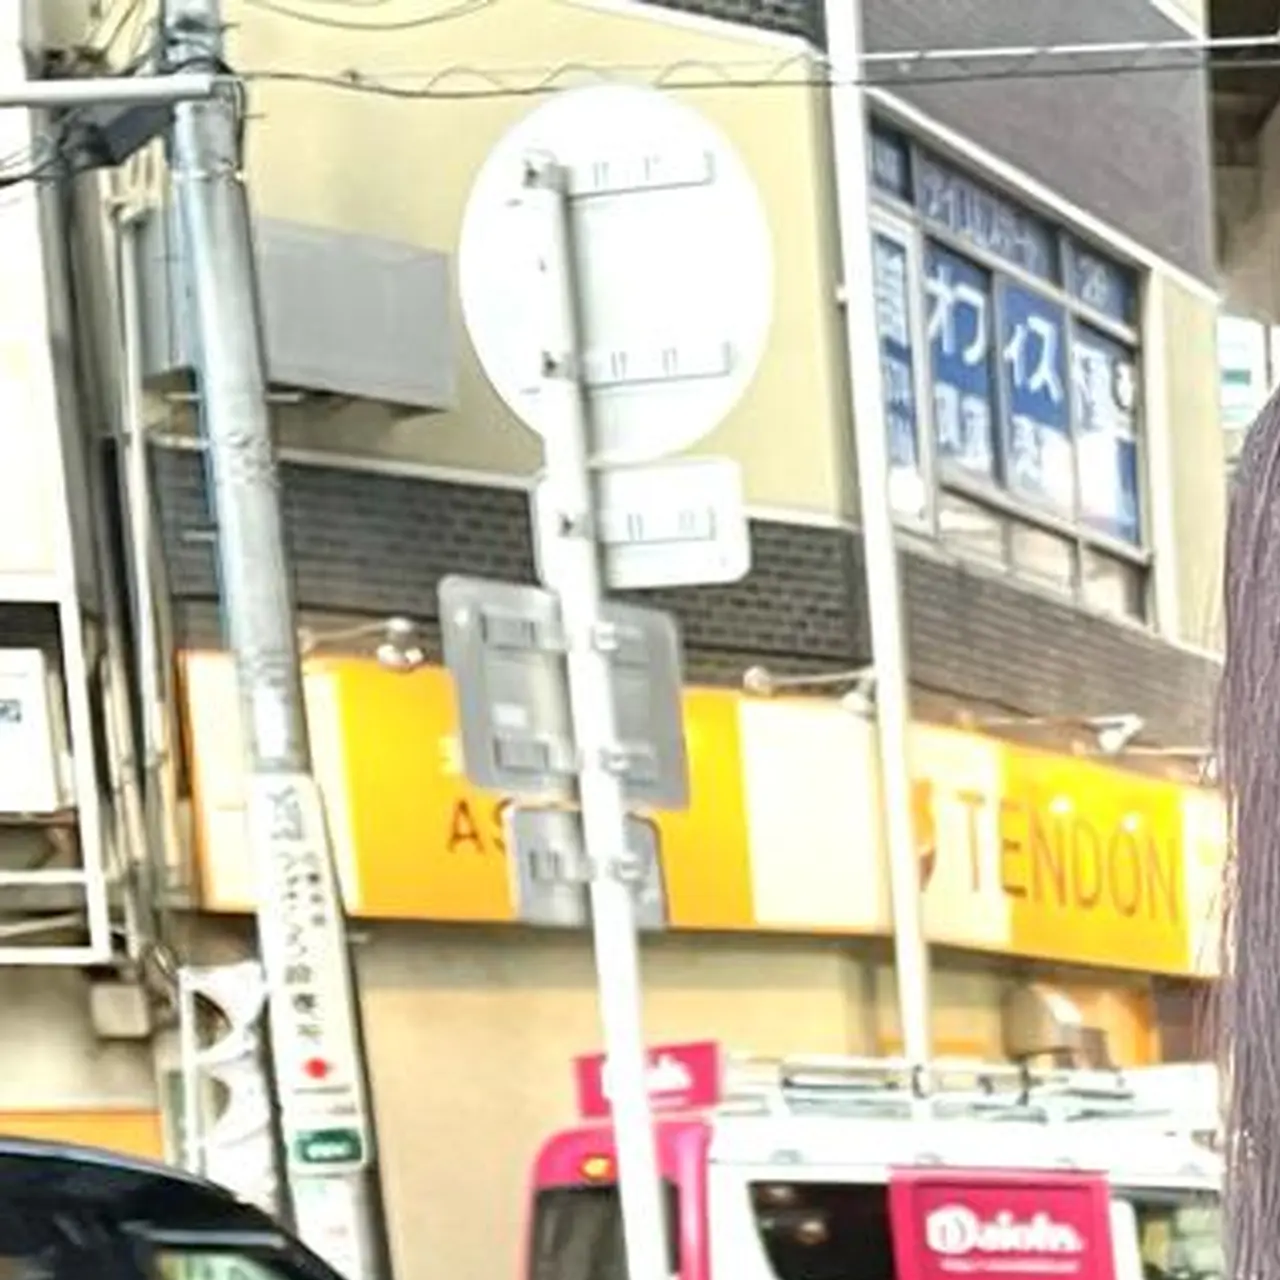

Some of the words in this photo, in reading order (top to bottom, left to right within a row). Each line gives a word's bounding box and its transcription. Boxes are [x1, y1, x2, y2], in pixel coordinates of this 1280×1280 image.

[926, 263, 1063, 403] オフィス
[956, 788, 1180, 926] TENDON
